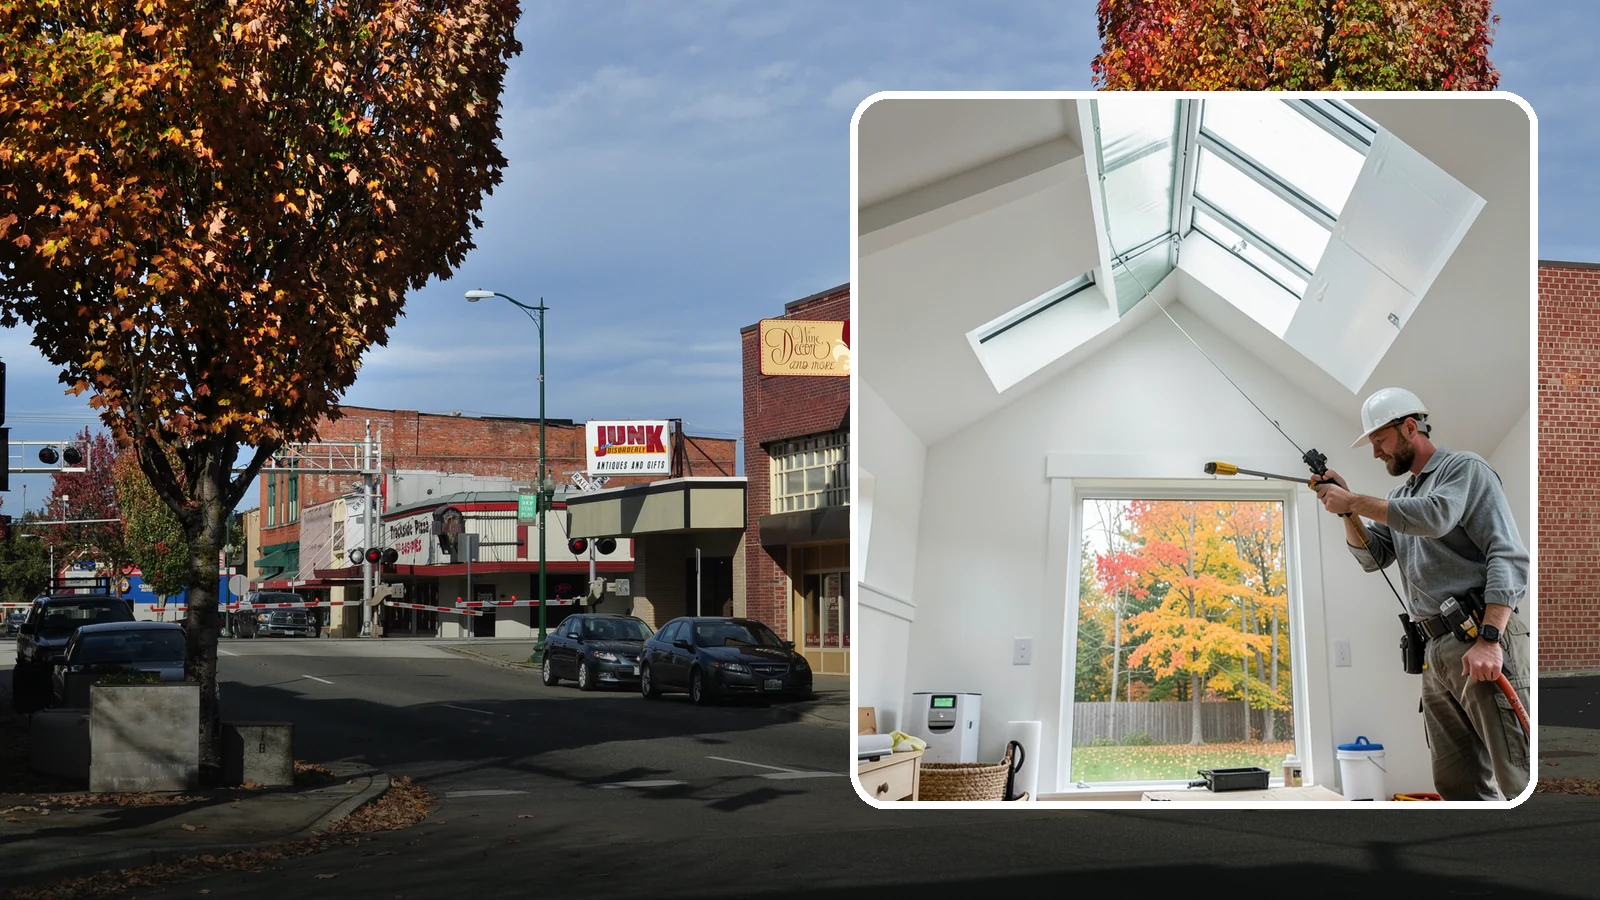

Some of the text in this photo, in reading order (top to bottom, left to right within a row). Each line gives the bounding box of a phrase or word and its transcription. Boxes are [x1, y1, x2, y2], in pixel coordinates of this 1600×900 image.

[595, 425, 665, 457] JUNK
[607, 446, 646, 454] DISORDERLY
[597, 460, 665, 470] ANTIQUES AND GIFTS
[390, 519, 429, 540] Trackside Pizza
